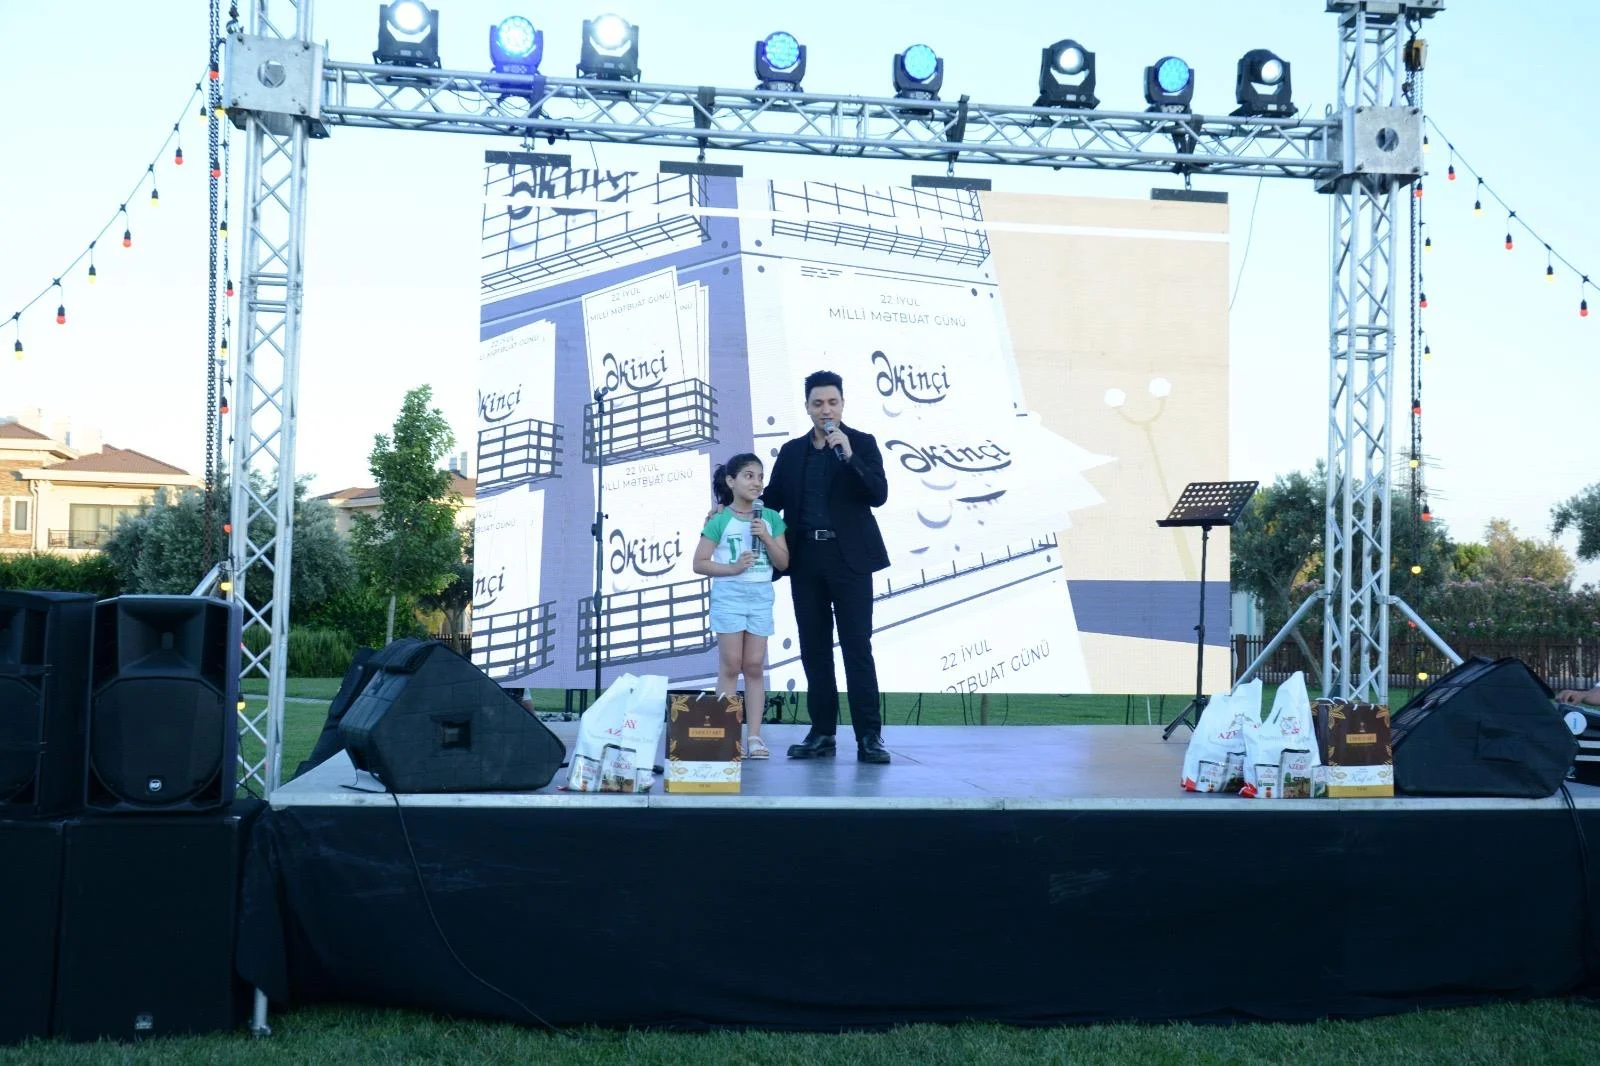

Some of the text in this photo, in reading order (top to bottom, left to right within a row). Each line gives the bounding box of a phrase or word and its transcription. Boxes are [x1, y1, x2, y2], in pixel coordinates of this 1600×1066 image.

[828, 305, 967, 328] MİLLİ MƏTBUAT GÜNÜ
[880, 294, 921, 307] 22 İYUL
[602, 350, 669, 391] Əkinçi
[871, 350, 951, 404] Əkinçi
[478, 383, 523, 422] kinçi
[625, 466, 637, 476] 22
[885, 439, 1012, 473] Əkinçi
[623, 473, 665, 488] MƏTBUAT
[609, 528, 683, 577] Əkinçi
[474, 566, 506, 610] nçi
[939, 638, 1051, 693] ƏTBUAT GÜNÜ
[940, 639, 993, 671] 22 İYUL
